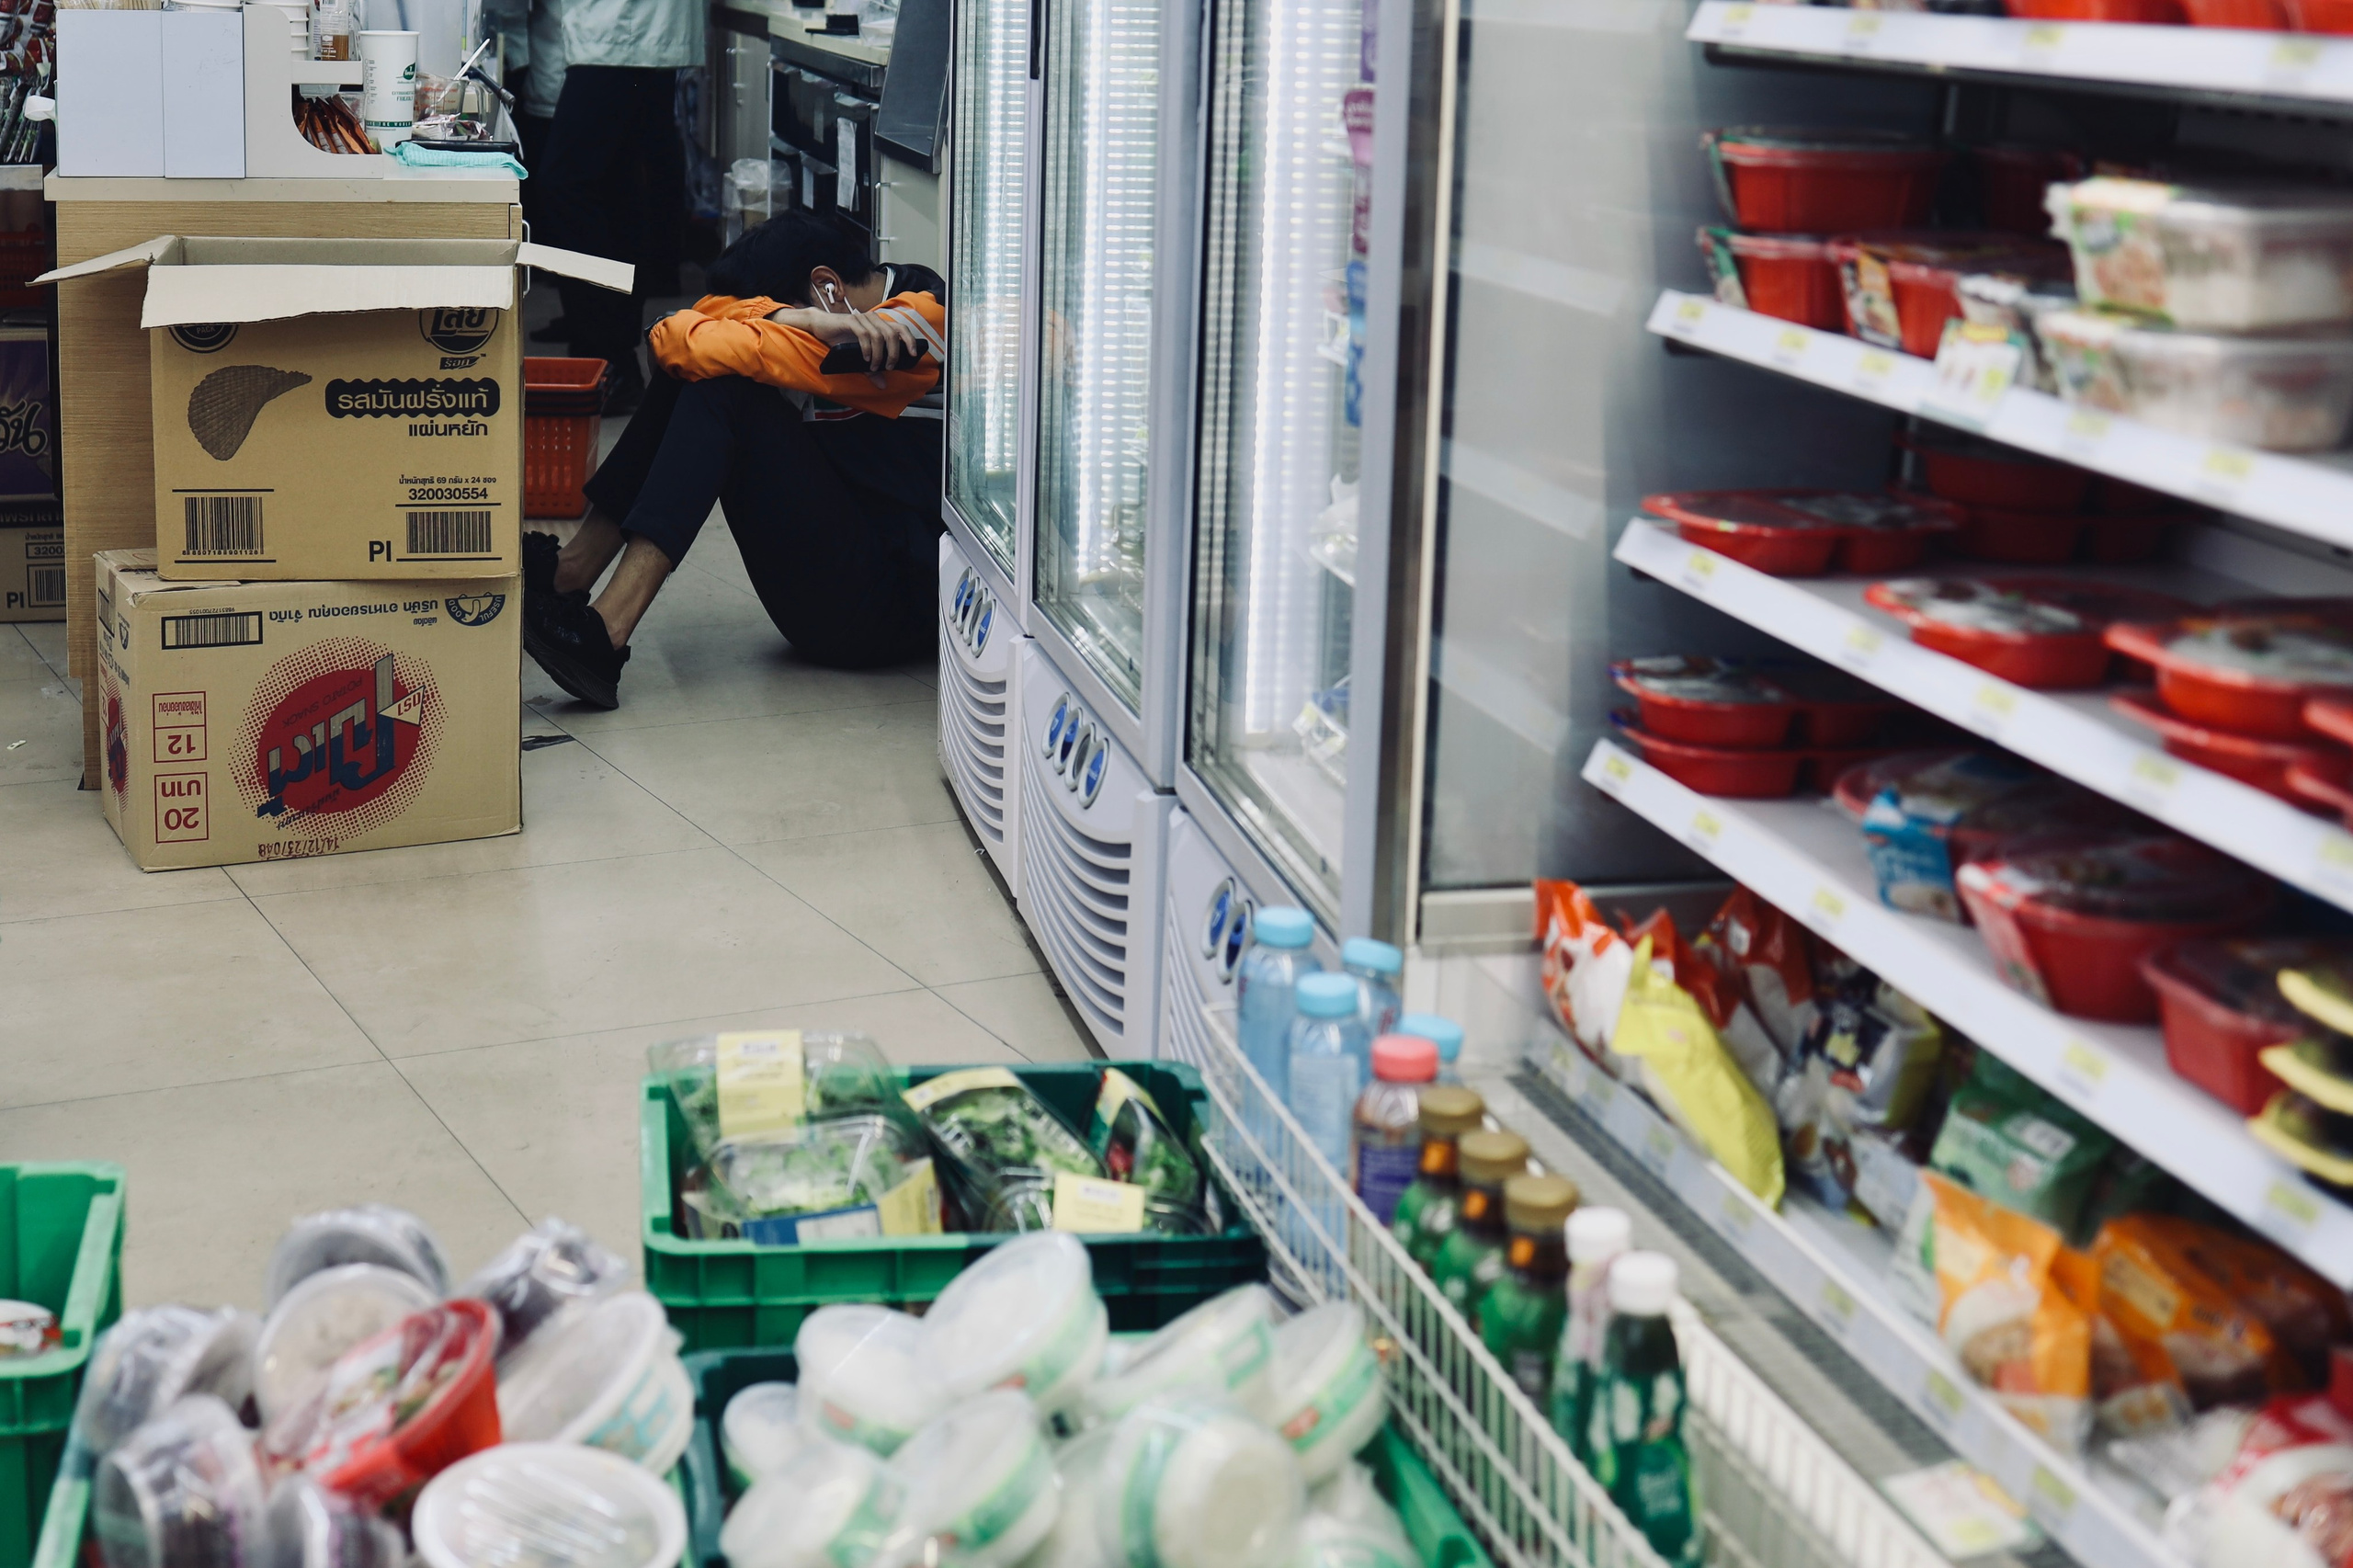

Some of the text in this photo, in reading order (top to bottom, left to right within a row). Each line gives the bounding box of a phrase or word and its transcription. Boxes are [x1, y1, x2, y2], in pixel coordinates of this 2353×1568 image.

[196, 325, 216, 334] PACK
[337, 384, 489, 410] รสมันฝรั่งแท้
[408, 419, 488, 437] แผ่นหยัก
[437, 476, 447, 484] 69
[449, 476, 463, 484] กรัม
[408, 487, 489, 501] 320030554
[34, 546, 64, 556] 3200
[369, 540, 392, 562] PI
[6, 592, 25, 609] PI
[268, 599, 438, 623] บริษัท อาหารยอดคุณ จำกัด
[478, 596, 502, 621] USEFUL
[282, 676, 363, 728] POTATO SNACK
[396, 692, 422, 717] ตรา
[167, 733, 197, 755] 12
[161, 779, 201, 798] บาท
[164, 807, 200, 831] 20
